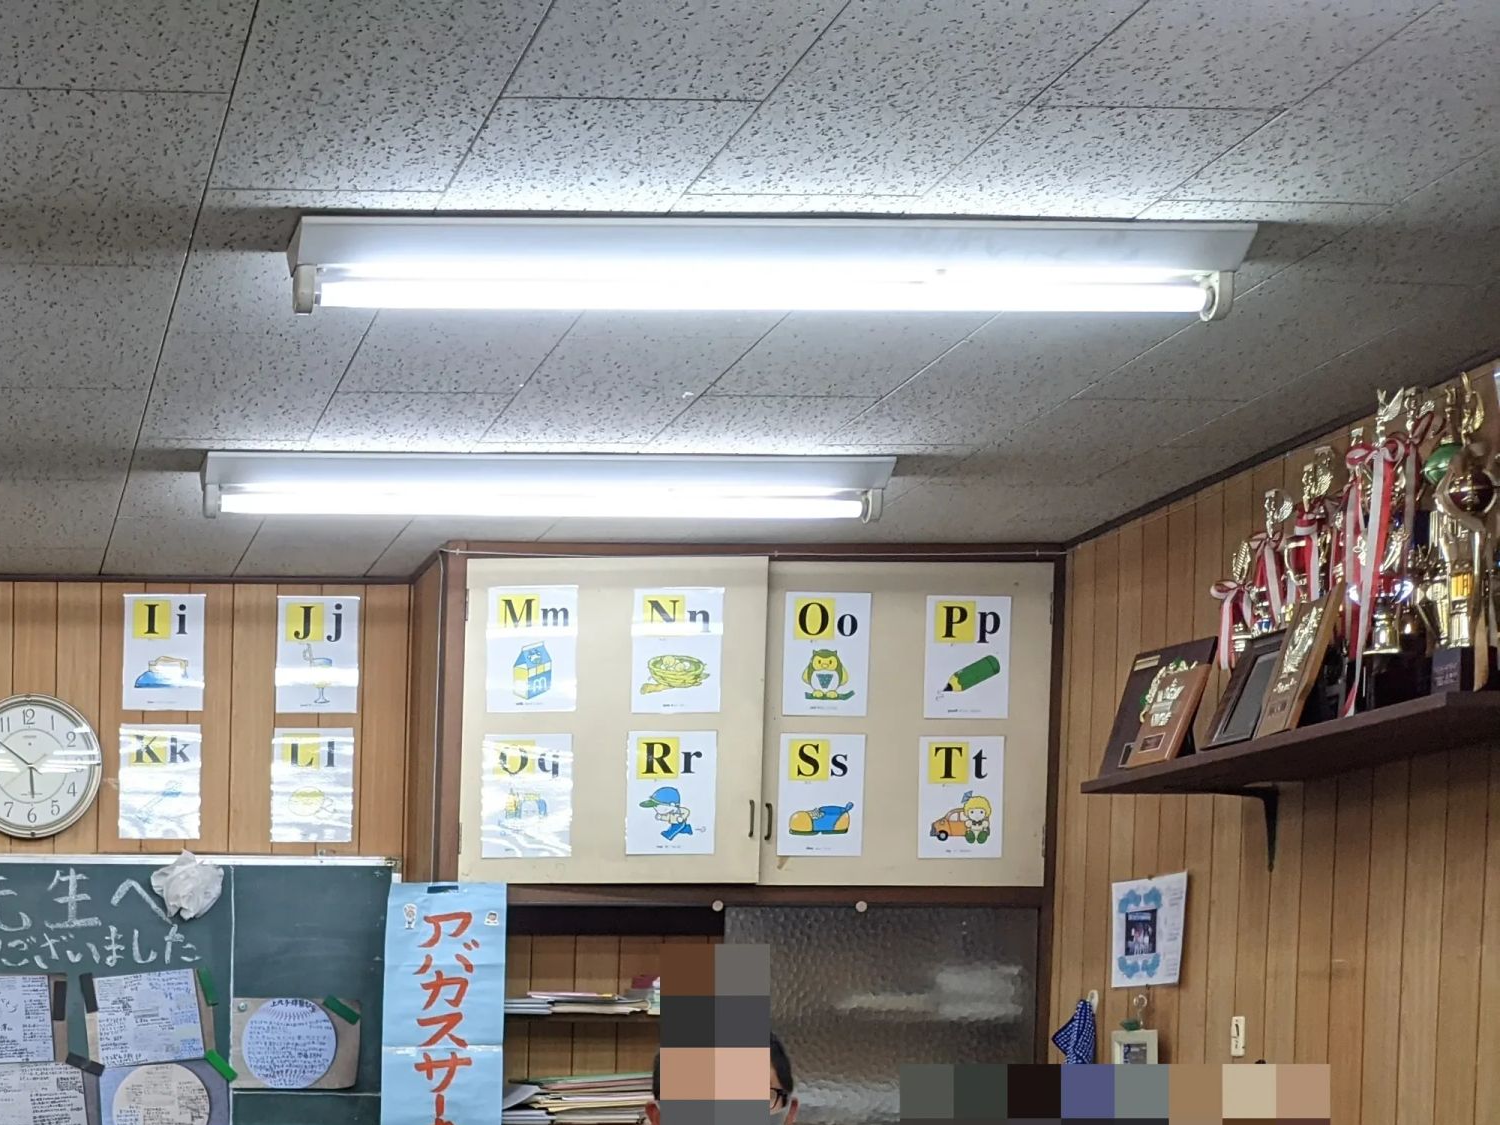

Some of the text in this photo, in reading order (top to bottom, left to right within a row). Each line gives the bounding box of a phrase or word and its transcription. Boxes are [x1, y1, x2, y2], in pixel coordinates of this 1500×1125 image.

[144, 603, 188, 635] Ii
[293, 603, 342, 642] Jj
[501, 599, 570, 628] Mm
[647, 600, 710, 633] Nn
[798, 602, 858, 637] Oo
[941, 604, 1001, 644] Pp
[0, 717, 10, 732] 11
[23, 709, 35, 725] 12
[66, 731, 76, 747] 2
[133, 734, 190, 766] Kk
[642, 742, 702, 776] Rr
[797, 743, 848, 778] Ss
[934, 747, 988, 780] Tt
[67, 782, 77, 797] 4
[4, 802, 14, 818] 7
[27, 808, 37, 823] 6
[51, 800, 60, 816] 5
